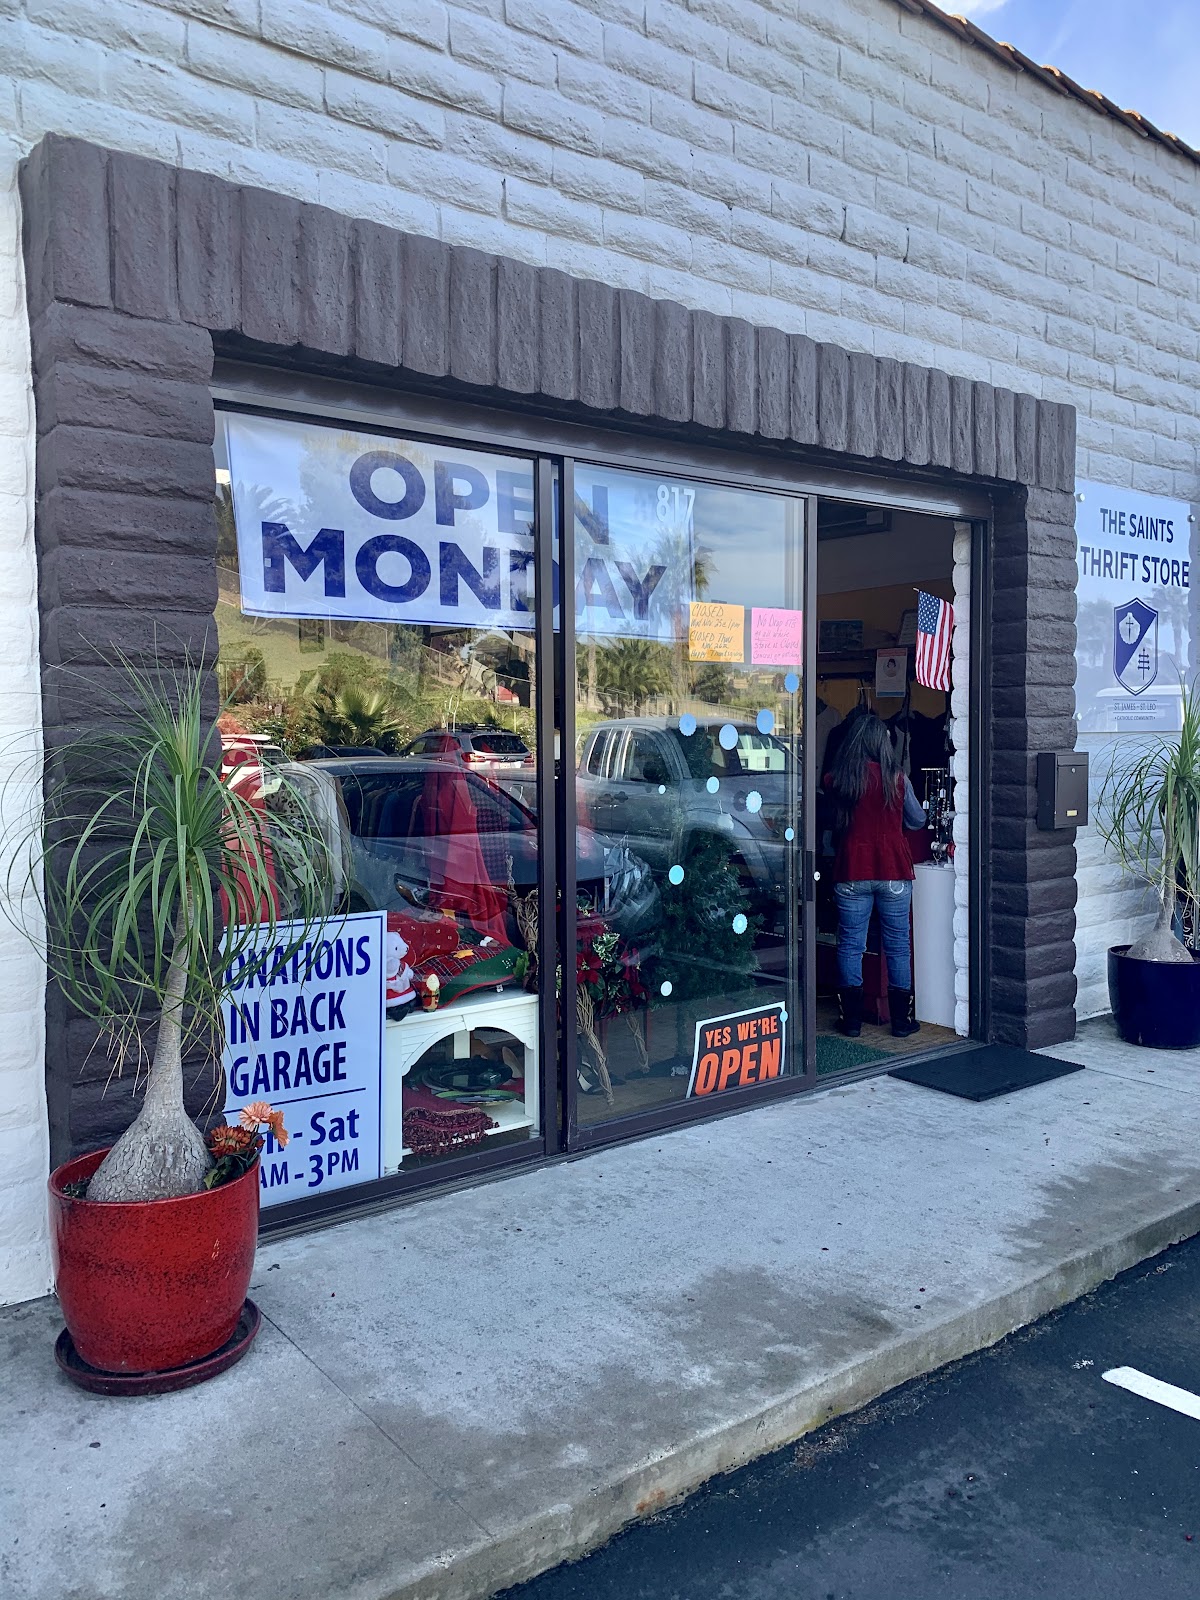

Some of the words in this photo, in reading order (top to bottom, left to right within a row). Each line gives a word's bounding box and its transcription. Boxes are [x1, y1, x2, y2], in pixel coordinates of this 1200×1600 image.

[350, 451, 609, 545] OPEN
[656, 484, 696, 522] 817
[1100, 508, 1126, 536] THE
[1129, 513, 1174, 544] SAINTS
[261, 521, 666, 622] MONDAY
[1080, 546, 1138, 582] THRIFT
[1141, 555, 1190, 588] STORE
[1121, 703, 1136, 711] JAMES
[1147, 703, 1156, 711] LEO
[225, 936, 371, 991] ONATIONS
[230, 1001, 260, 1045] IN
[270, 990, 347, 1040] BACK
[705, 1026, 731, 1049] YES
[737, 1015, 778, 1042] WE'RE
[229, 1041, 347, 1097] GARAGE
[694, 1037, 781, 1096] OPEN
[310, 1108, 360, 1146] Sat
